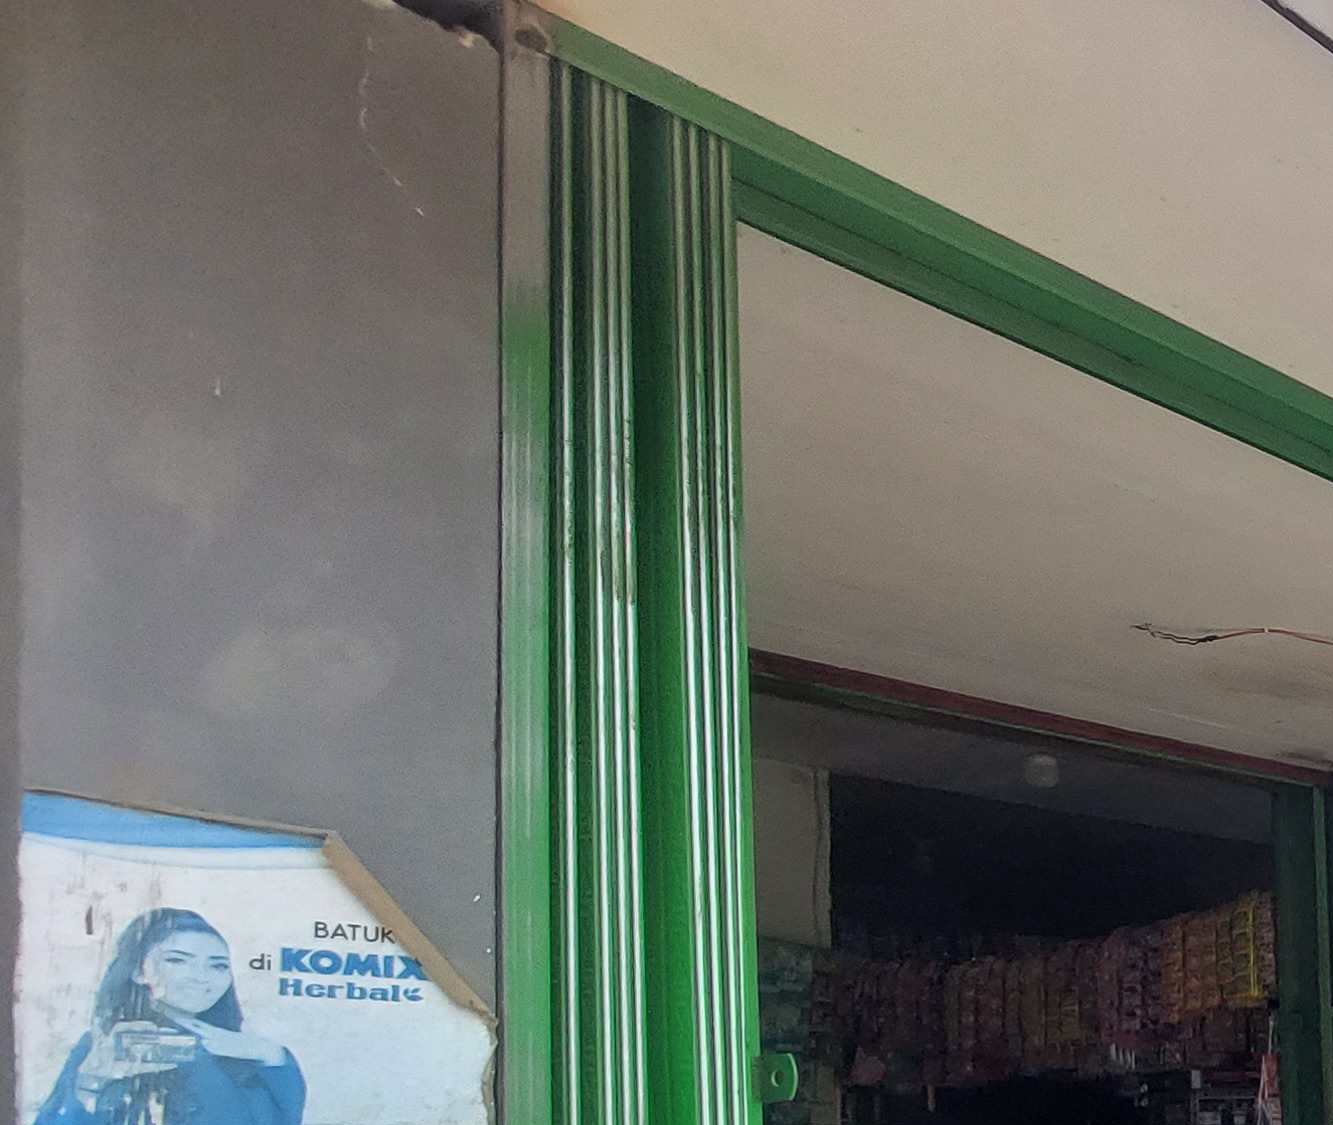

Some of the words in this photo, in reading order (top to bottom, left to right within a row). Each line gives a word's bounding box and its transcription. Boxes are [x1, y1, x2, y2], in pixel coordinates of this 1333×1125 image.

[313, 921, 395, 944] BATUK
[249, 953, 272, 971] di
[280, 948, 429, 981] KOMIX
[279, 977, 401, 1002] Herbal
